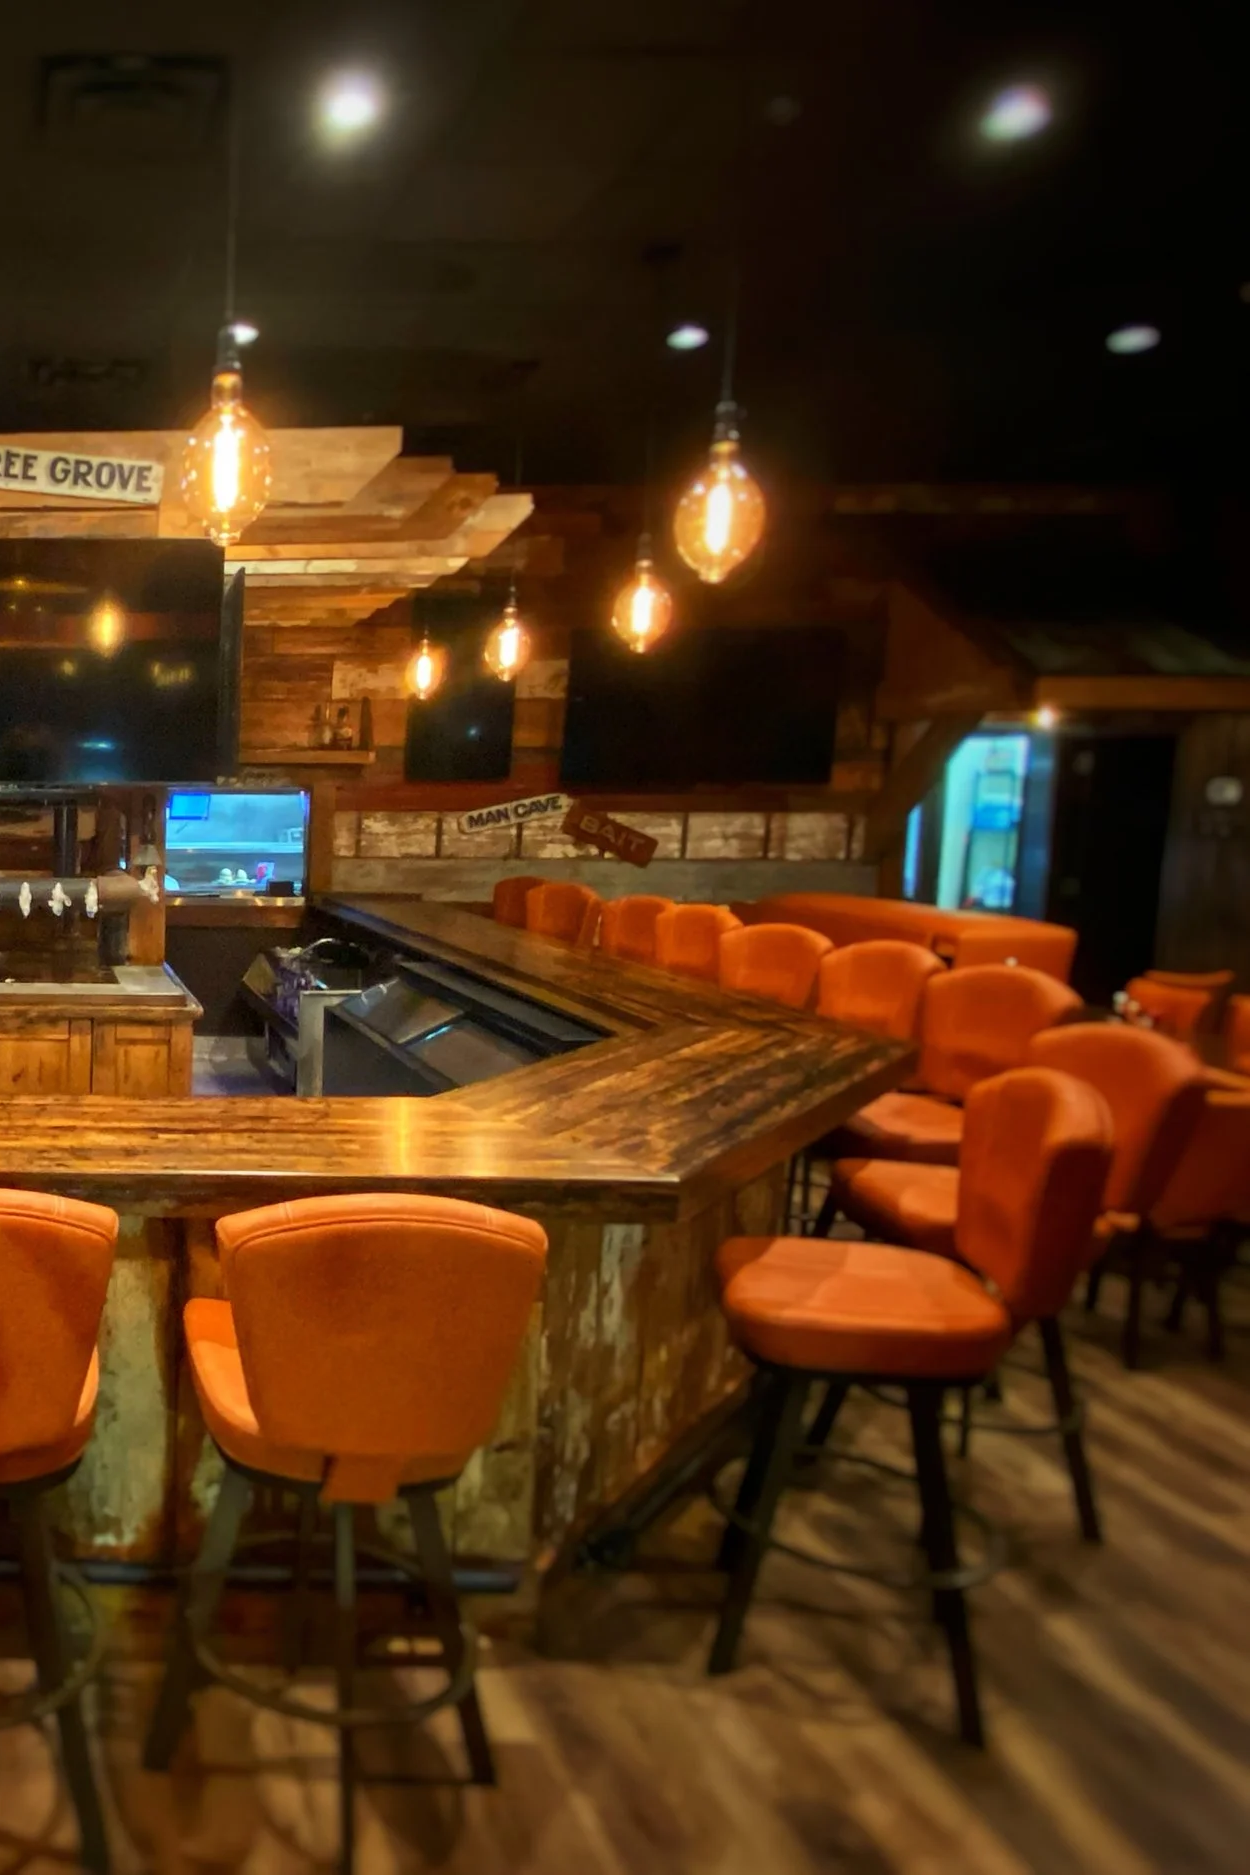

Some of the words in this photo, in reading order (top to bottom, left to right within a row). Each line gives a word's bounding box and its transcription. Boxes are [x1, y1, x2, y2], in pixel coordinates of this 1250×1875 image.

[49, 455, 153, 493] GROVE
[467, 807, 511, 829] MAN
[512, 795, 563, 819] CAVE
[579, 814, 647, 852] BAIT
